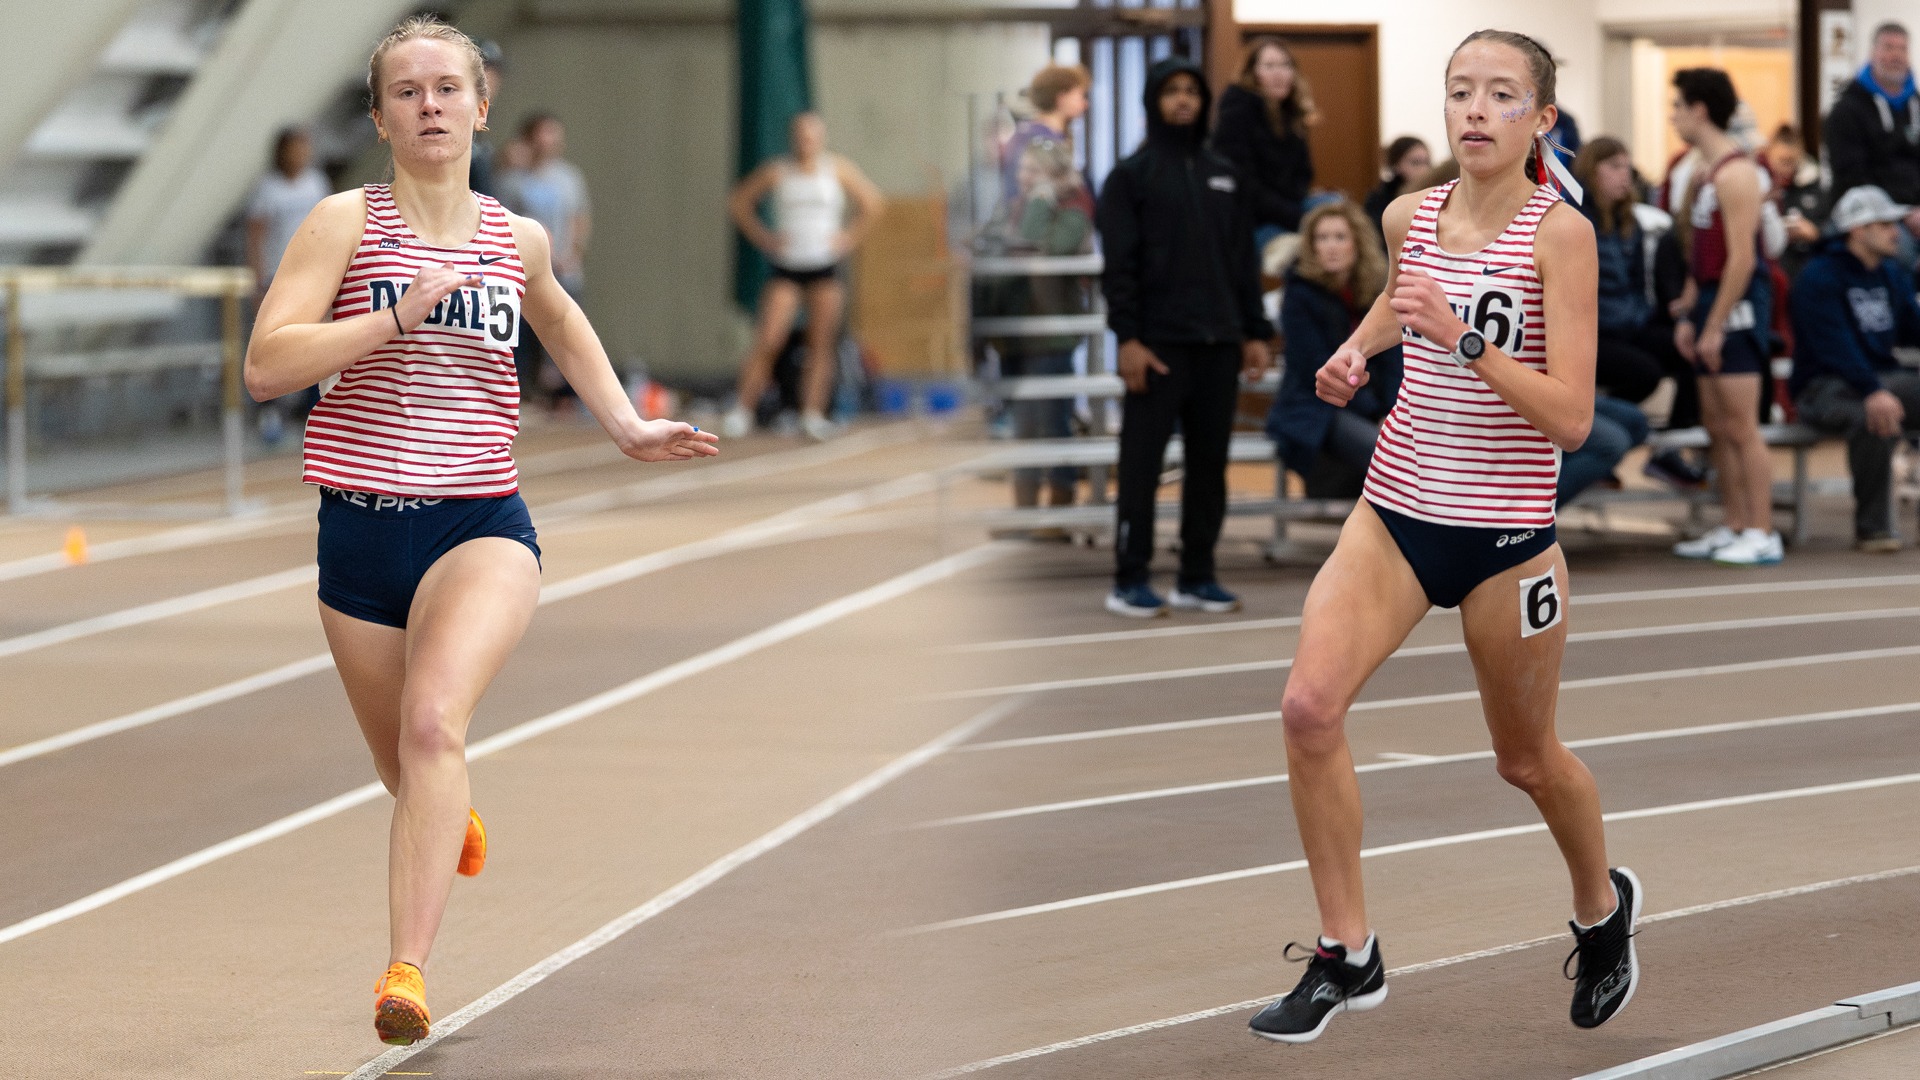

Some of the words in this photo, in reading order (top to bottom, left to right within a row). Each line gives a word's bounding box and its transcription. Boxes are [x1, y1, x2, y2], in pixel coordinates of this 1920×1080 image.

[380, 241, 400, 249] MAC
[486, 285, 514, 342] 5
[1474, 290, 1513, 350] 6
[1509, 529, 1536, 545] asics
[1527, 576, 1558, 630] 6
